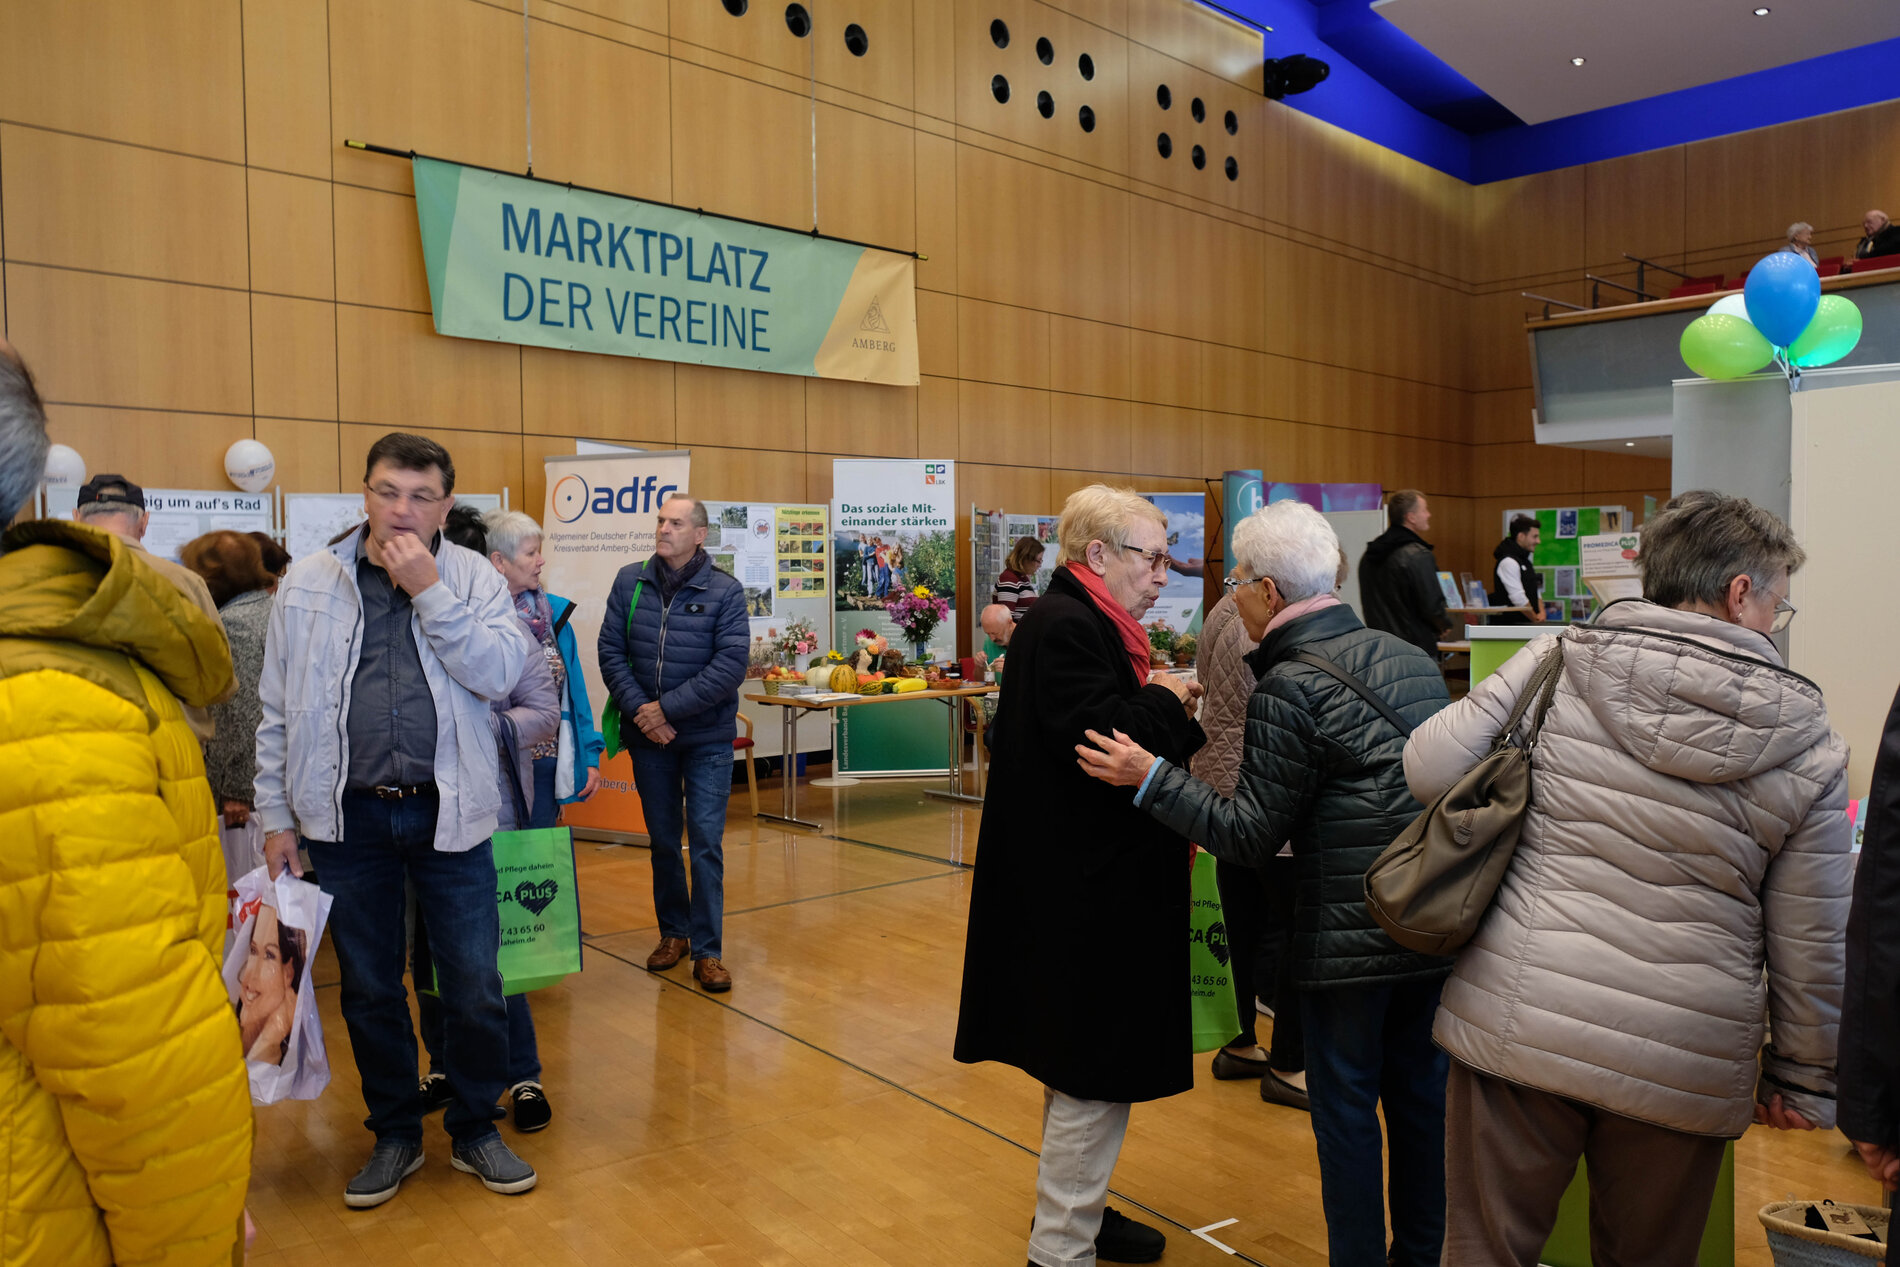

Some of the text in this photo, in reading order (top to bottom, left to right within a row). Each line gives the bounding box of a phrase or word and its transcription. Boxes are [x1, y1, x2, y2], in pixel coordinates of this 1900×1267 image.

[501, 202, 771, 293] MARKTPLATZ
[503, 272, 771, 353] DER VEREINE
[852, 337, 896, 353] AMBERG
[591, 475, 678, 514] adfc
[168, 498, 190, 508] um
[195, 497, 230, 511] auf's
[234, 498, 261, 511] Rad
[841, 503, 936, 513] Das soziale Mit-
[841, 516, 947, 526] einander stärken
[549, 531, 589, 543] Allgemeiner
[590, 530, 627, 541] Deutscher
[553, 543, 599, 553] Kreisverband
[841, 717, 849, 770] Landesverband
[505, 865, 527, 873] Pflege
[529, 863, 554, 871] daheim
[520, 888, 552, 901] PLUS
[506, 927, 518, 936] 43
[520, 925, 532, 934] 65
[533, 923, 545, 932] 60
[1203, 976, 1215, 986] 65
[1216, 976, 1228, 987] 60
